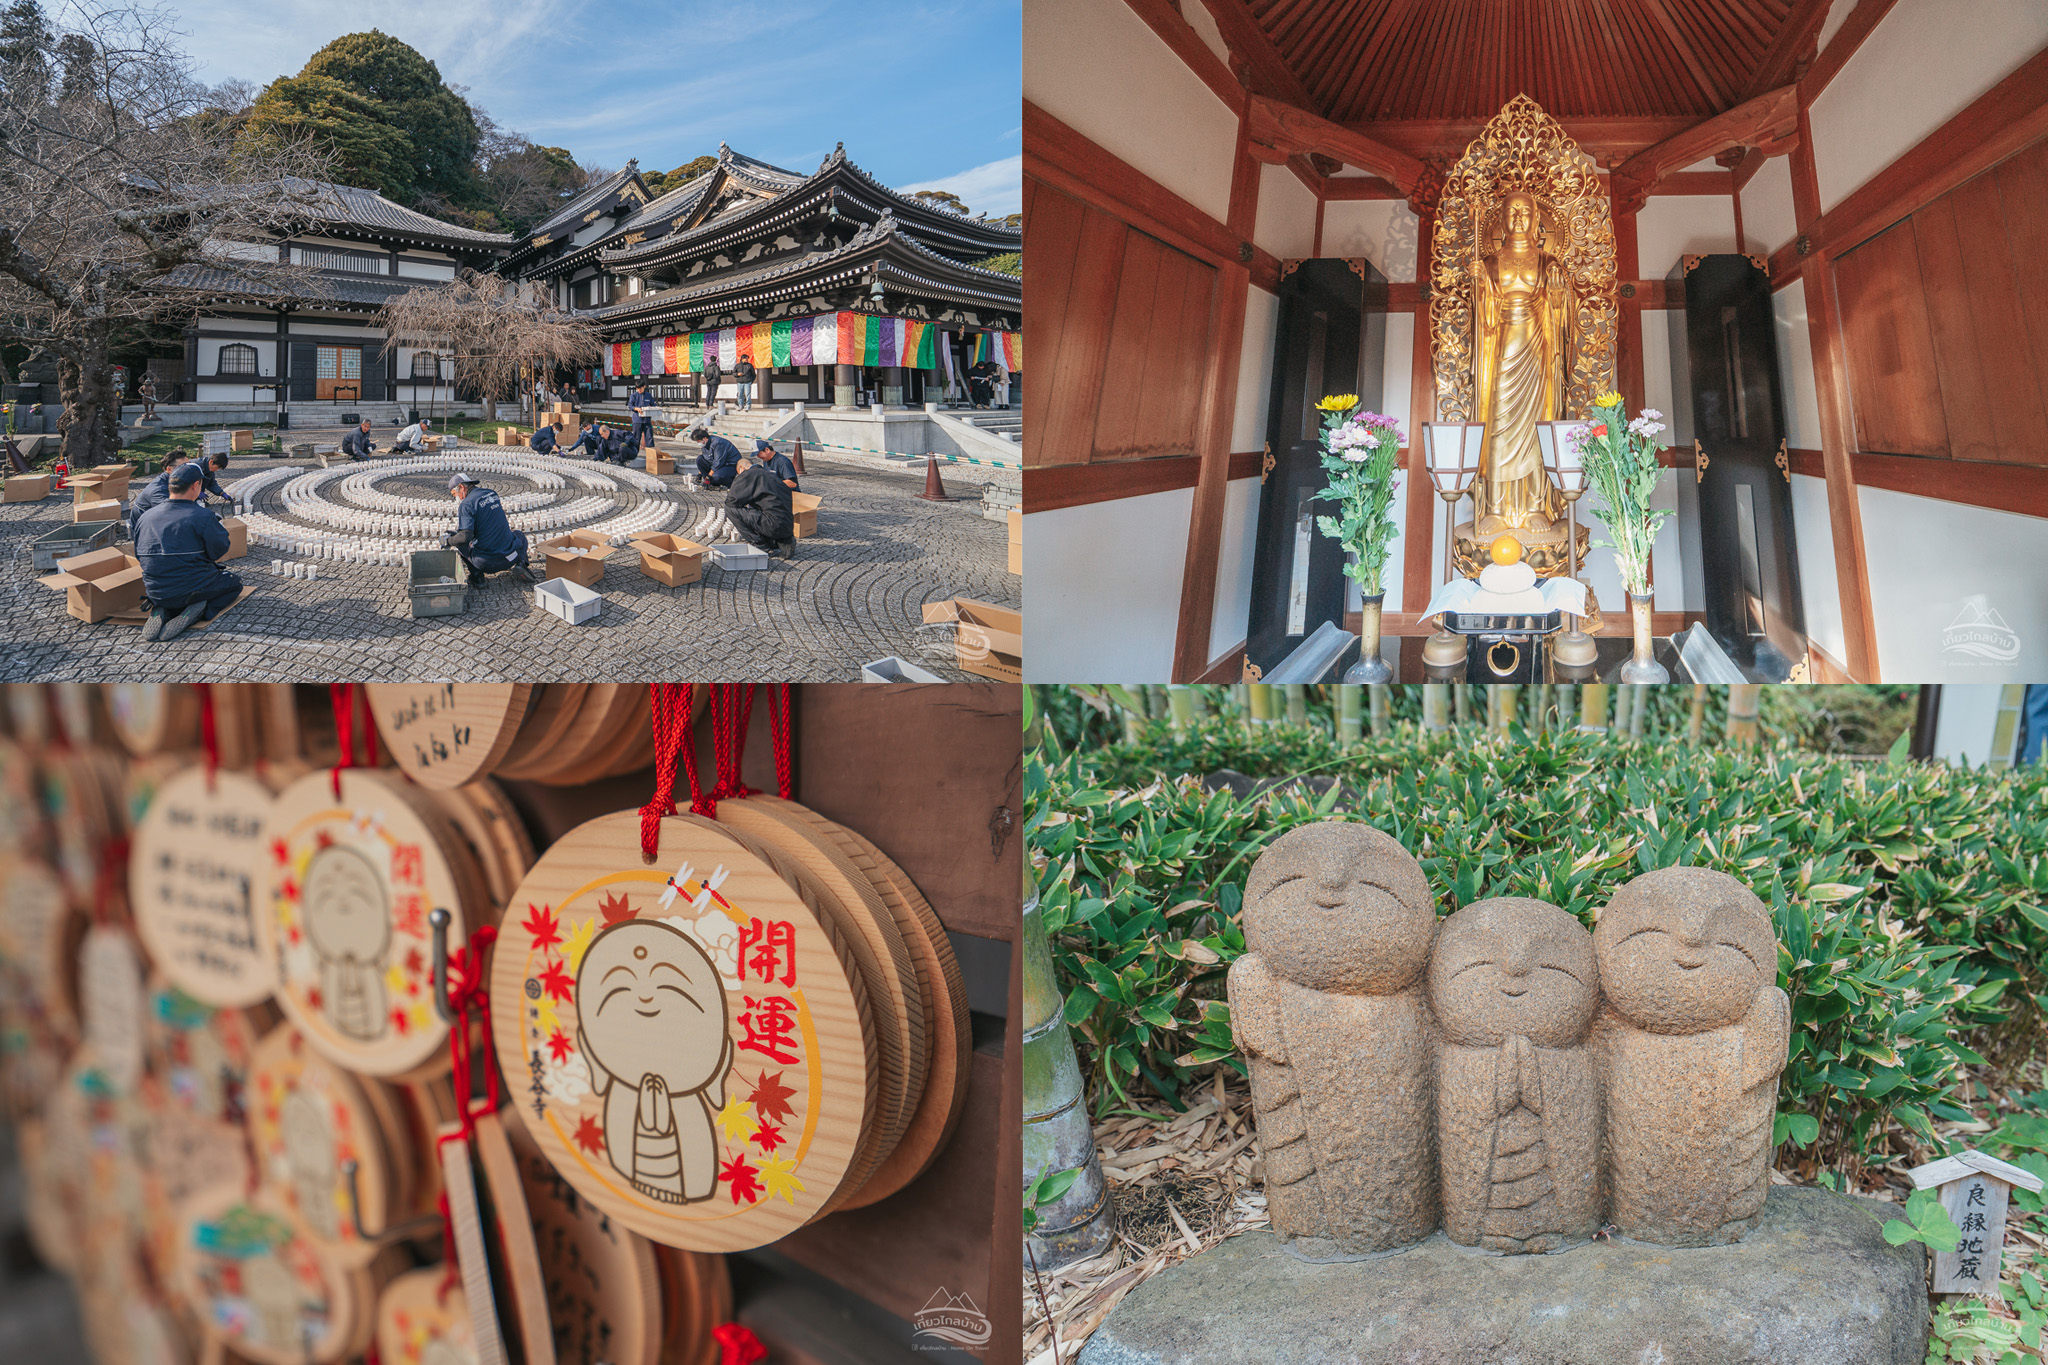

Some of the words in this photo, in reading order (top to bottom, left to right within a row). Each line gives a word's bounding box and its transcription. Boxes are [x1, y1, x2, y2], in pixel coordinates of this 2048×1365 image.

[736, 916, 800, 1065] 開運
[1952, 1183, 1988, 1281] 良縁地蔵
